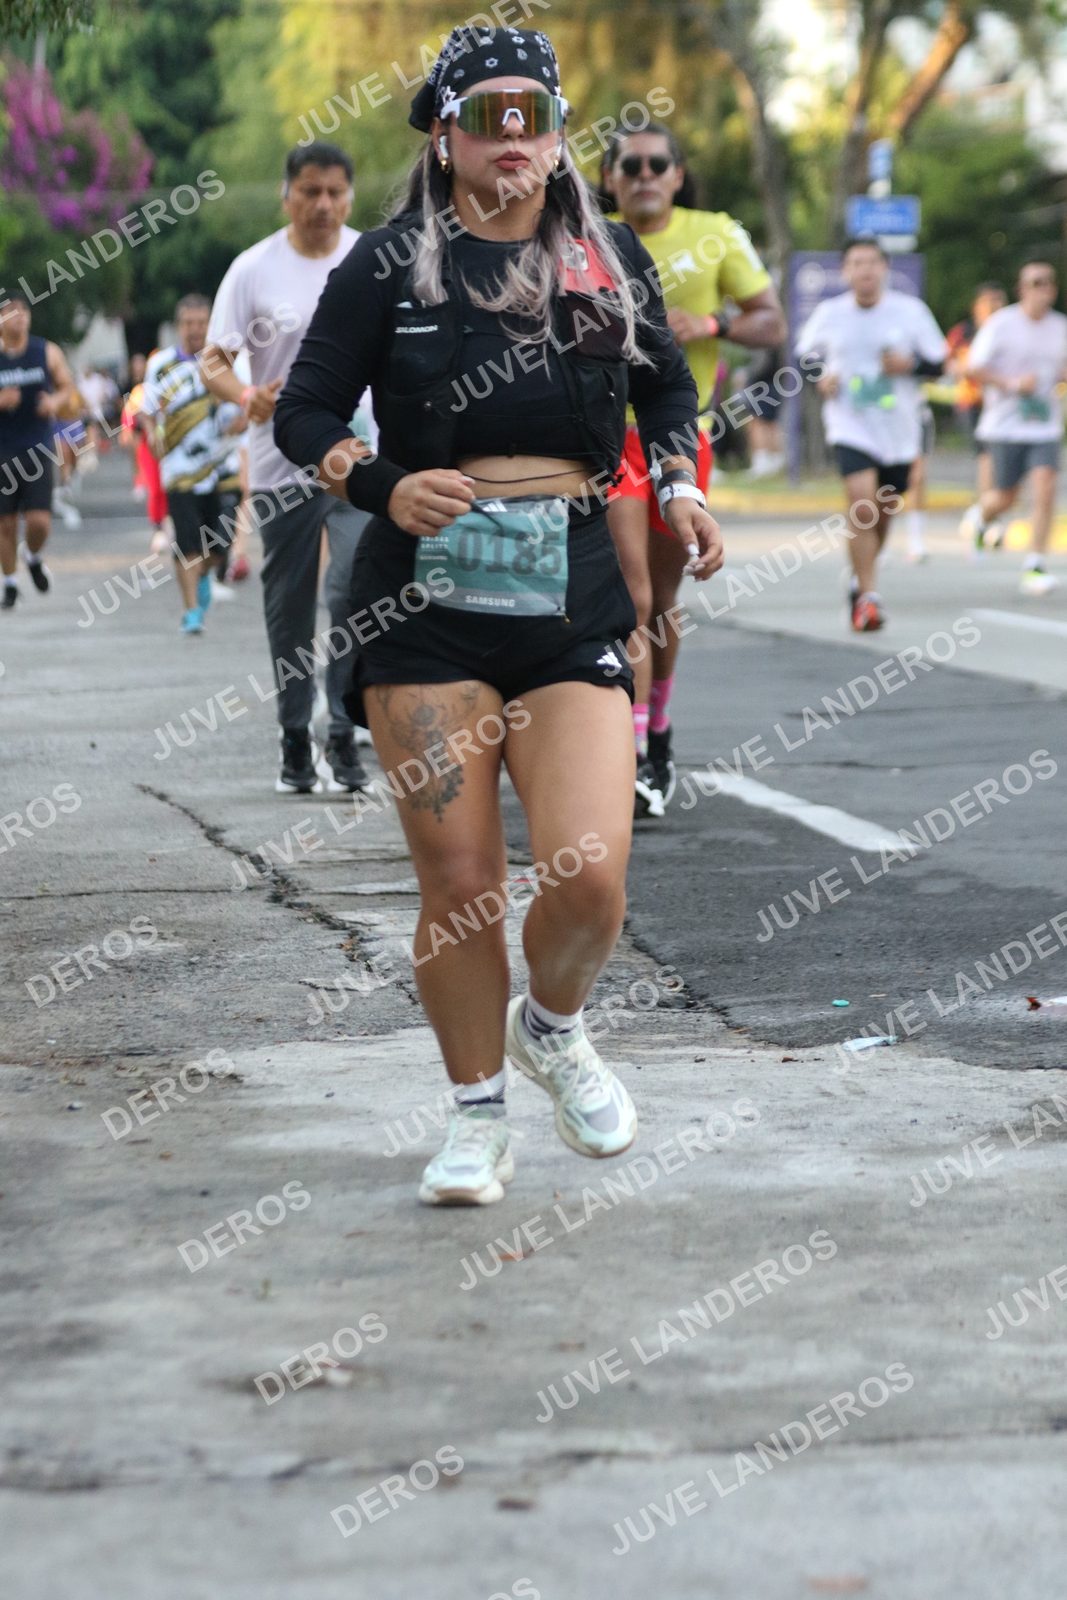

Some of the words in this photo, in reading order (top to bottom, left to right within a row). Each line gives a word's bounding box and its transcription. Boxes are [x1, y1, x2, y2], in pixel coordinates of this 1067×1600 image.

[395, 324, 438, 334] SALOMON
[457, 527, 562, 575] 0185
[465, 595, 516, 607] SAMSUNG
